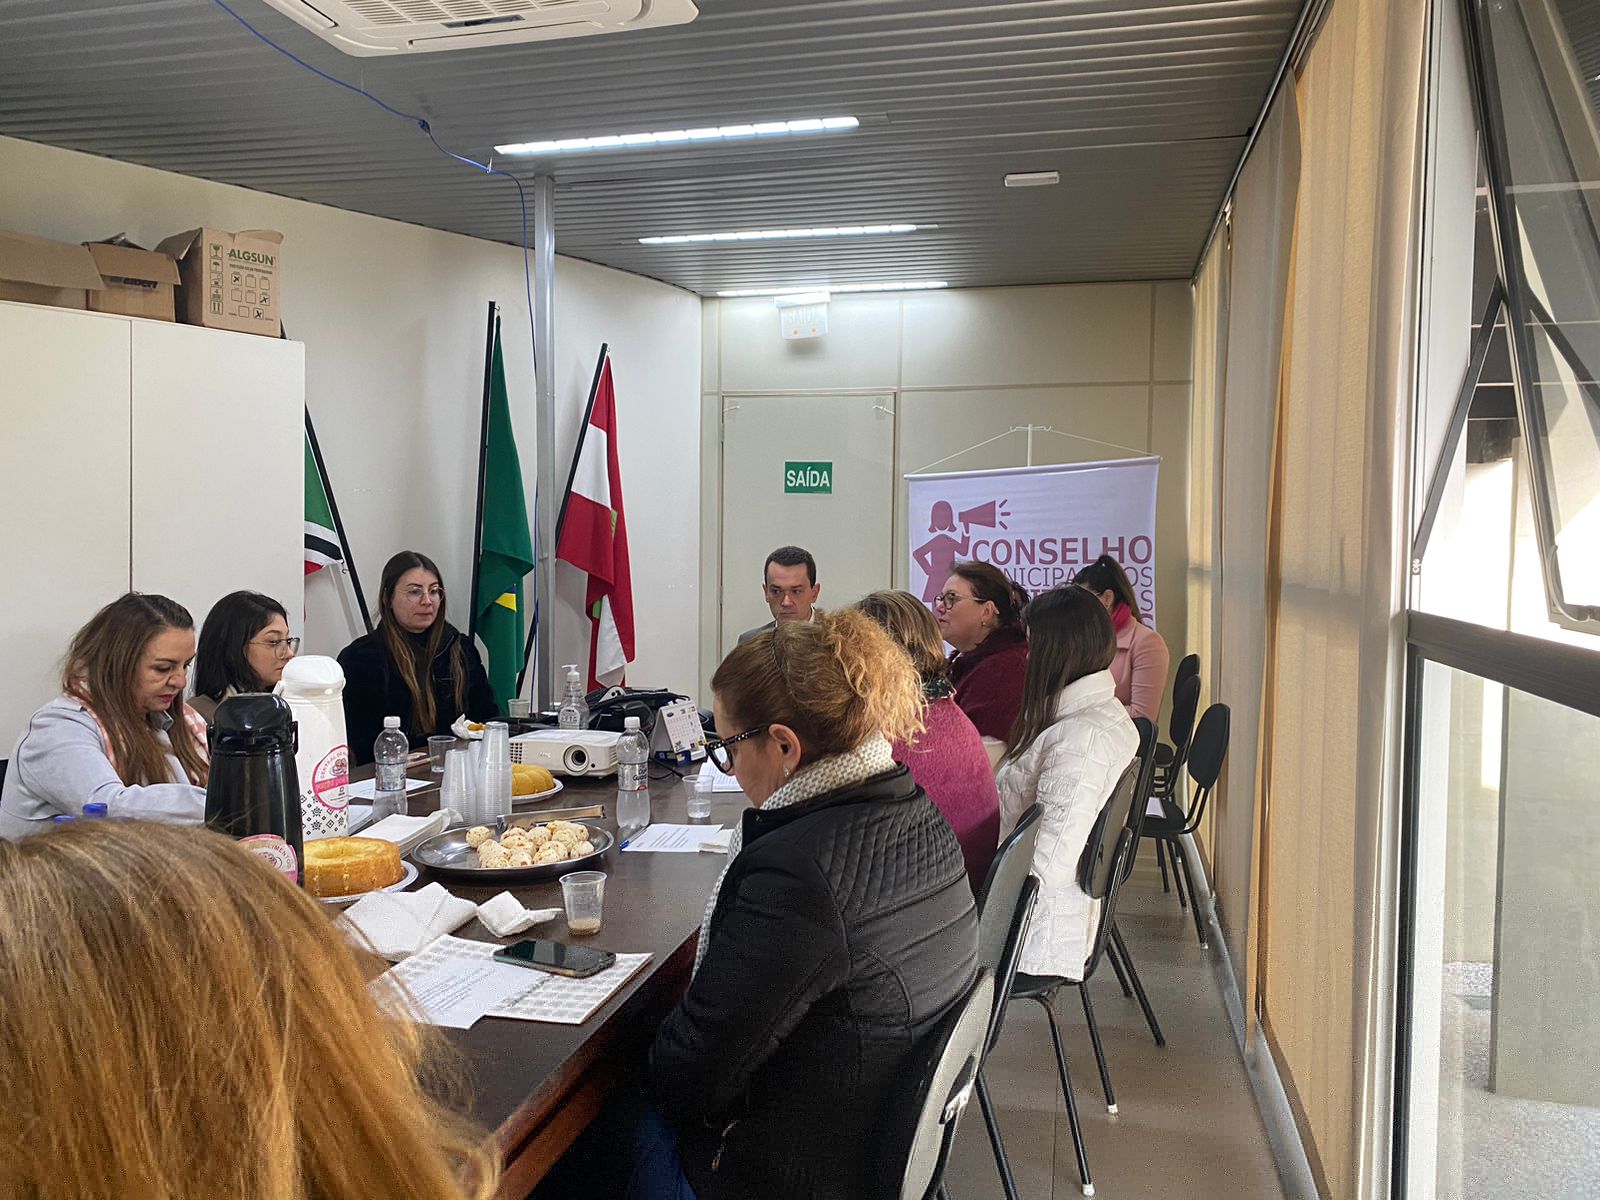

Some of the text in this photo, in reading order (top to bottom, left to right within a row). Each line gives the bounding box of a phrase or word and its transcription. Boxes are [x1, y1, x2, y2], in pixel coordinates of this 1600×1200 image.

[228, 248, 274, 266] ALGSUN
[786, 466, 830, 487] SAÍDA
[971, 535, 1153, 565] CONSELHO
[1001, 566, 1153, 588] NICIPA OS
